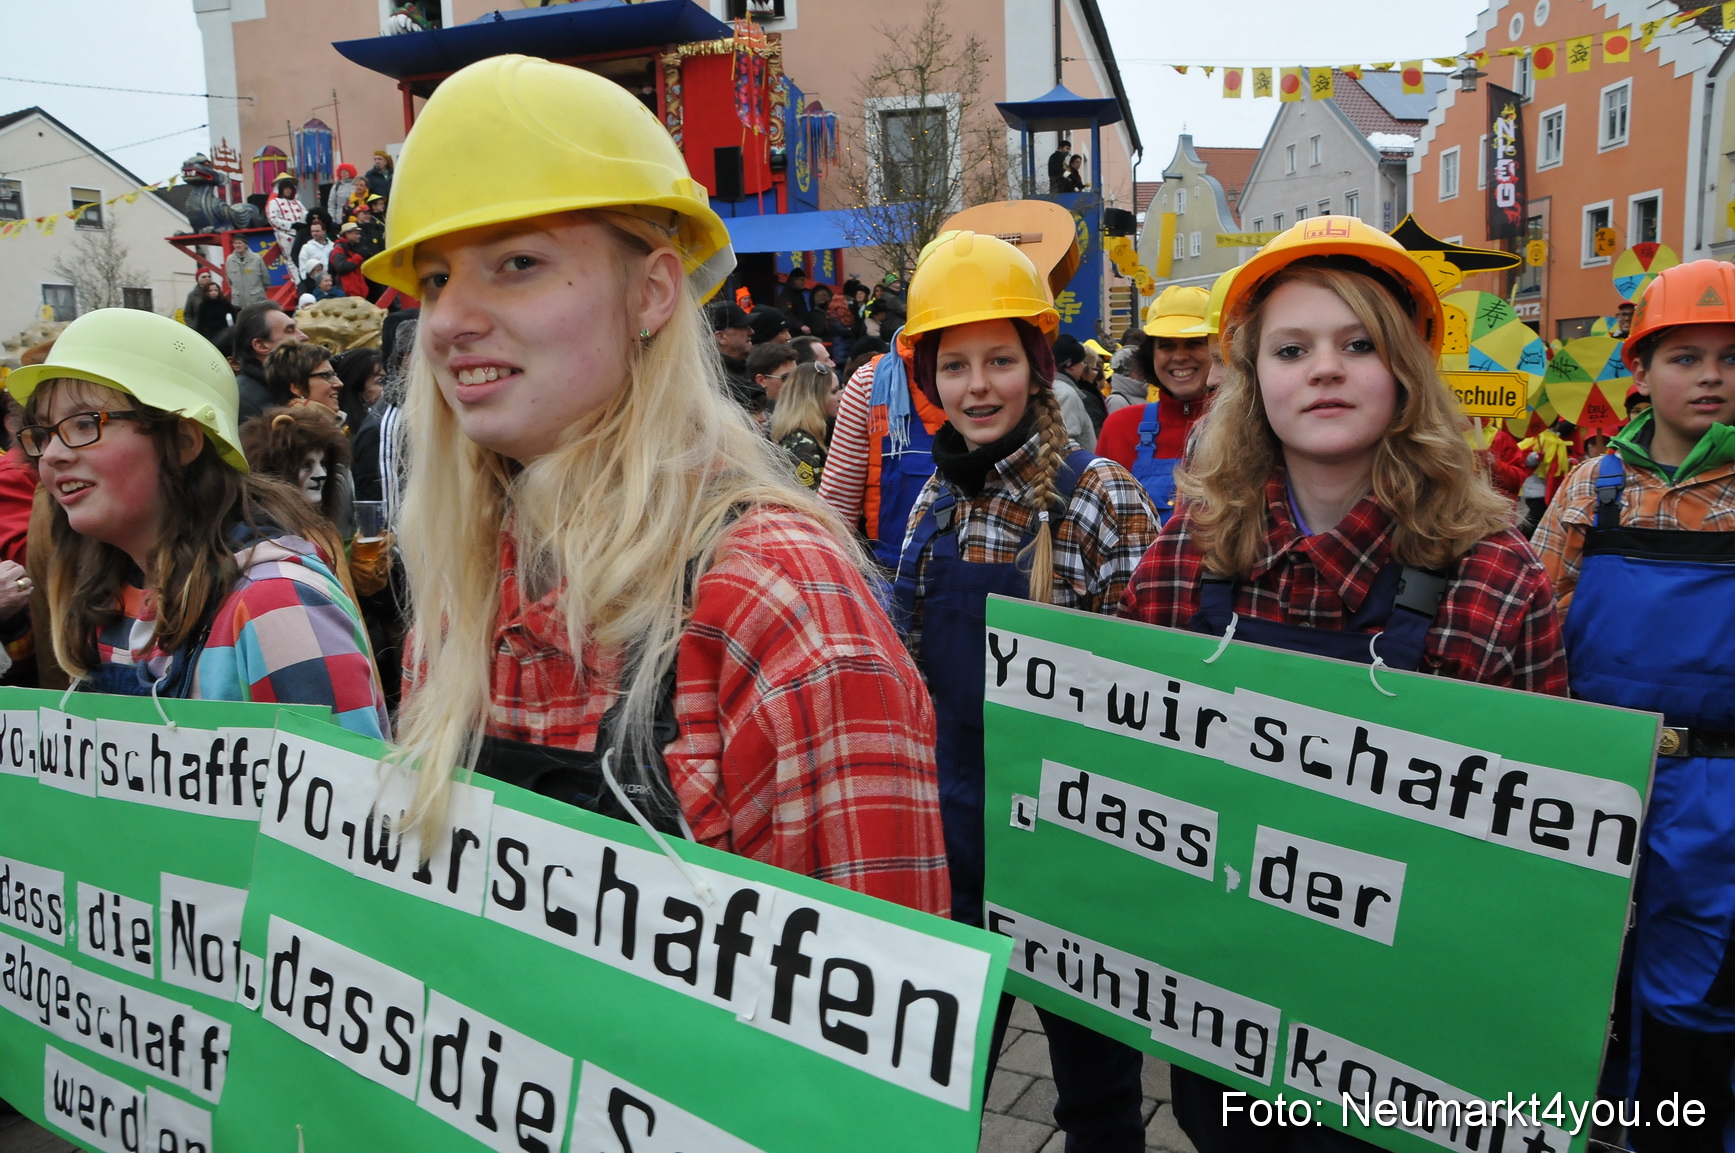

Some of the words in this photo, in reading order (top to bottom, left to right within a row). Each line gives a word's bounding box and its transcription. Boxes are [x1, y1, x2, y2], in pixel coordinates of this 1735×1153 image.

[1383, 201, 1391, 234] UHR
[1449, 385, 1517, 407] schule
[40, 719, 94, 779] wir
[1107, 681, 1227, 749] wir
[1250, 716, 1637, 866] schaffen
[0, 864, 62, 936] dass
[88, 893, 151, 965] die
[1057, 771, 1210, 868] dass
[1259, 846, 1391, 928] der
[3, 944, 229, 1092] abgeschaff
[364, 801, 480, 894] wr
[492, 837, 959, 1087] schaffen
[988, 909, 1268, 1079] Frühling
[271, 935, 415, 1076] dass
[430, 1016, 555, 1153] die
